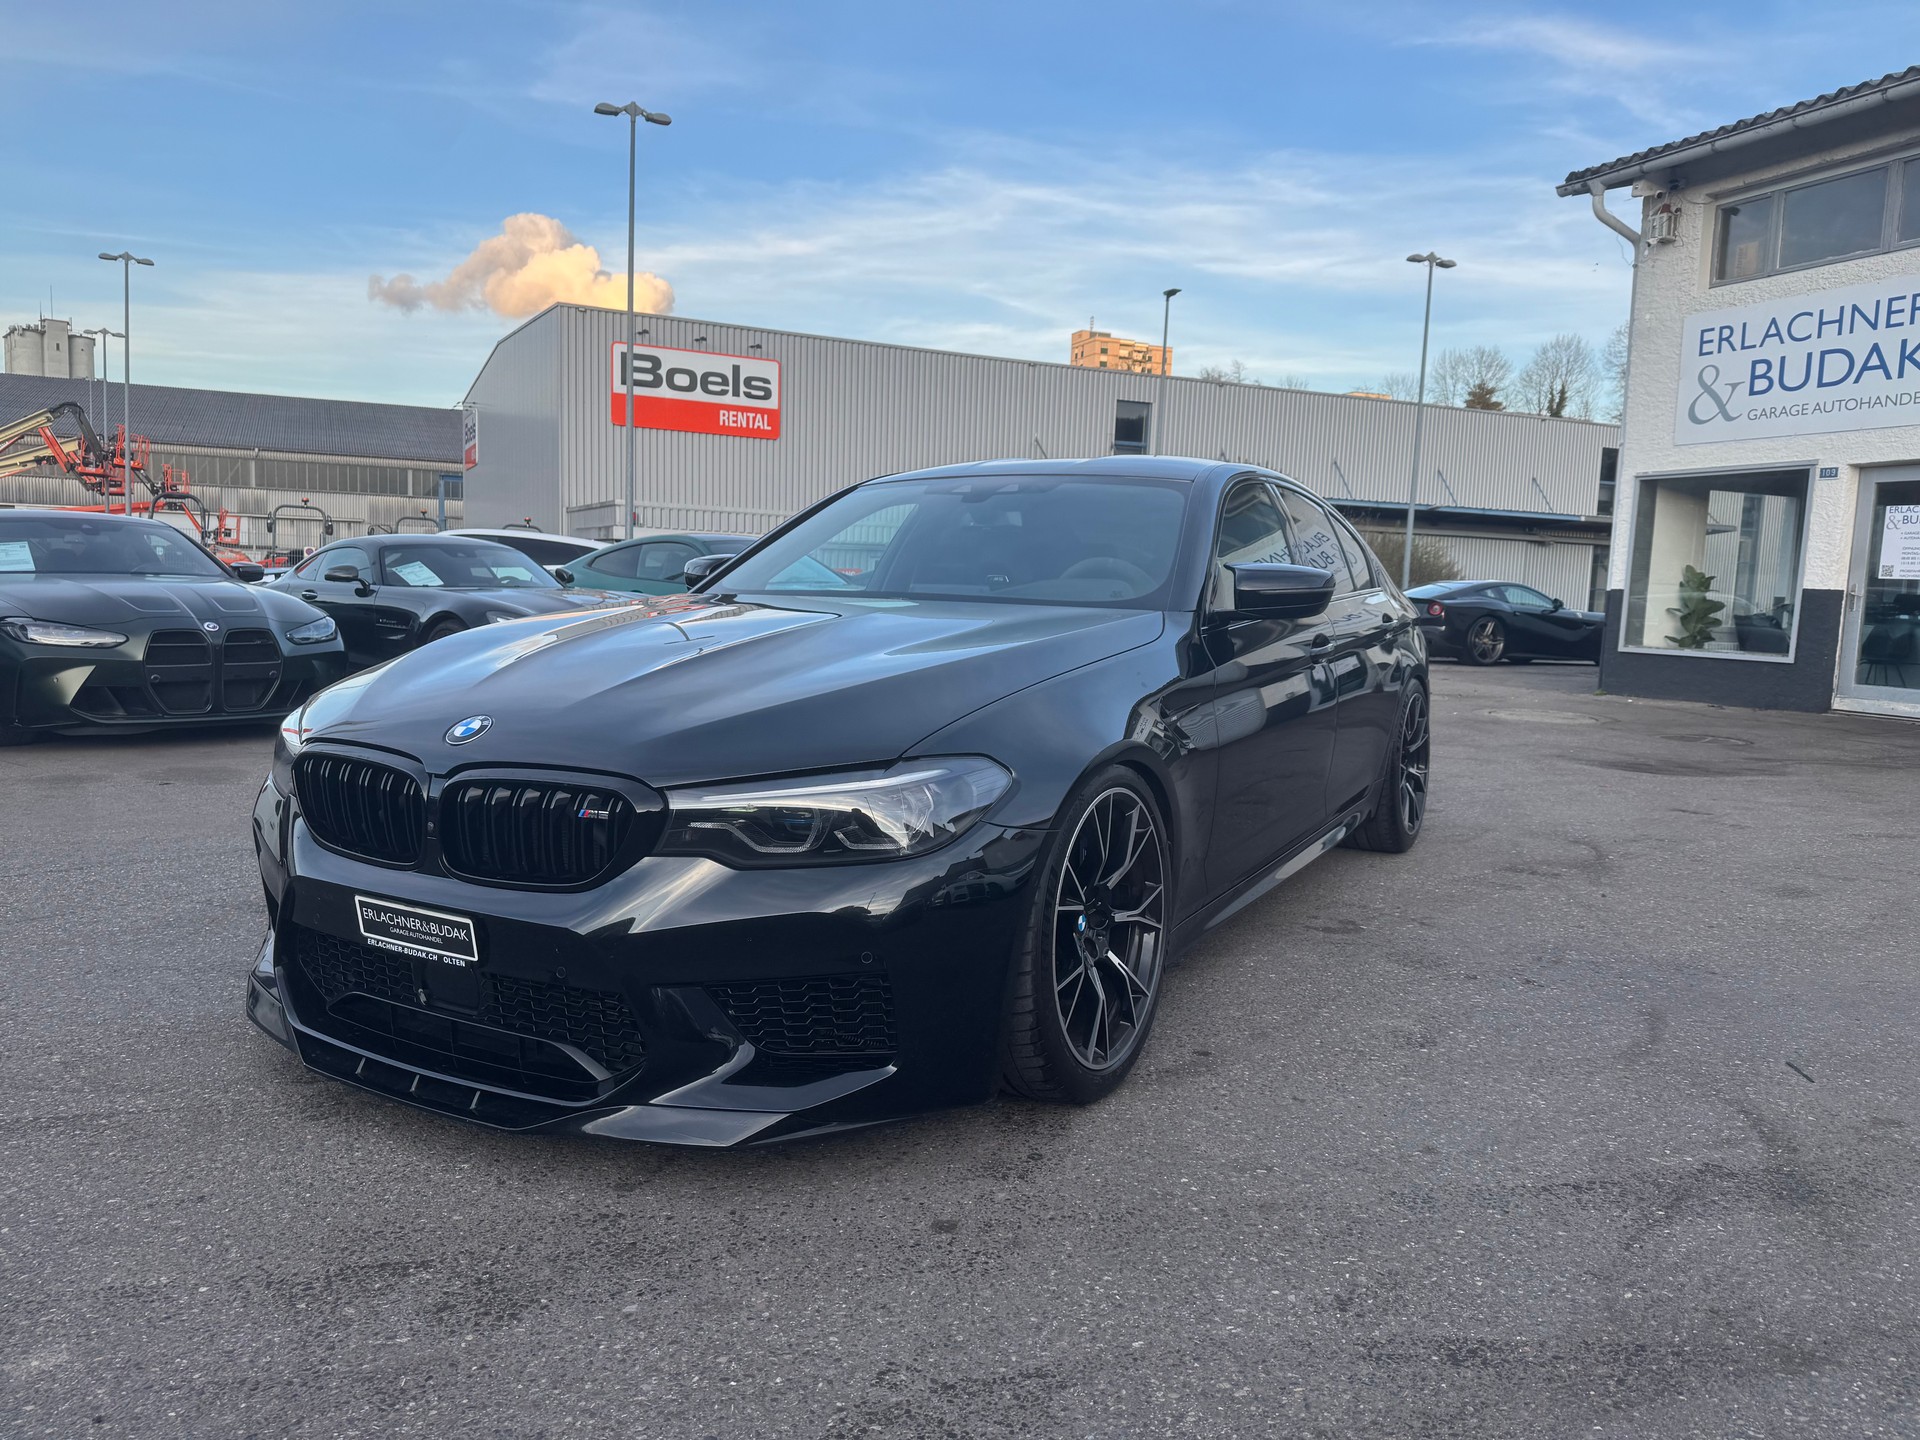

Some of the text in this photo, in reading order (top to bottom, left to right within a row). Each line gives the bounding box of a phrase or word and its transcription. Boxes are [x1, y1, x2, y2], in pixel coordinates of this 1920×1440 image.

[620, 351, 773, 401] Boels
[1688, 338, 1920, 425] & BUDAK
[719, 409, 772, 431] RENTAL
[1747, 402, 1810, 421] GARAGE
[1821, 468, 1836, 477] 109
[362, 907, 469, 942] ERLACHNER&BUDAK
[367, 938, 466, 968] ERLACHNER-BUDAK.CH OLTEN
